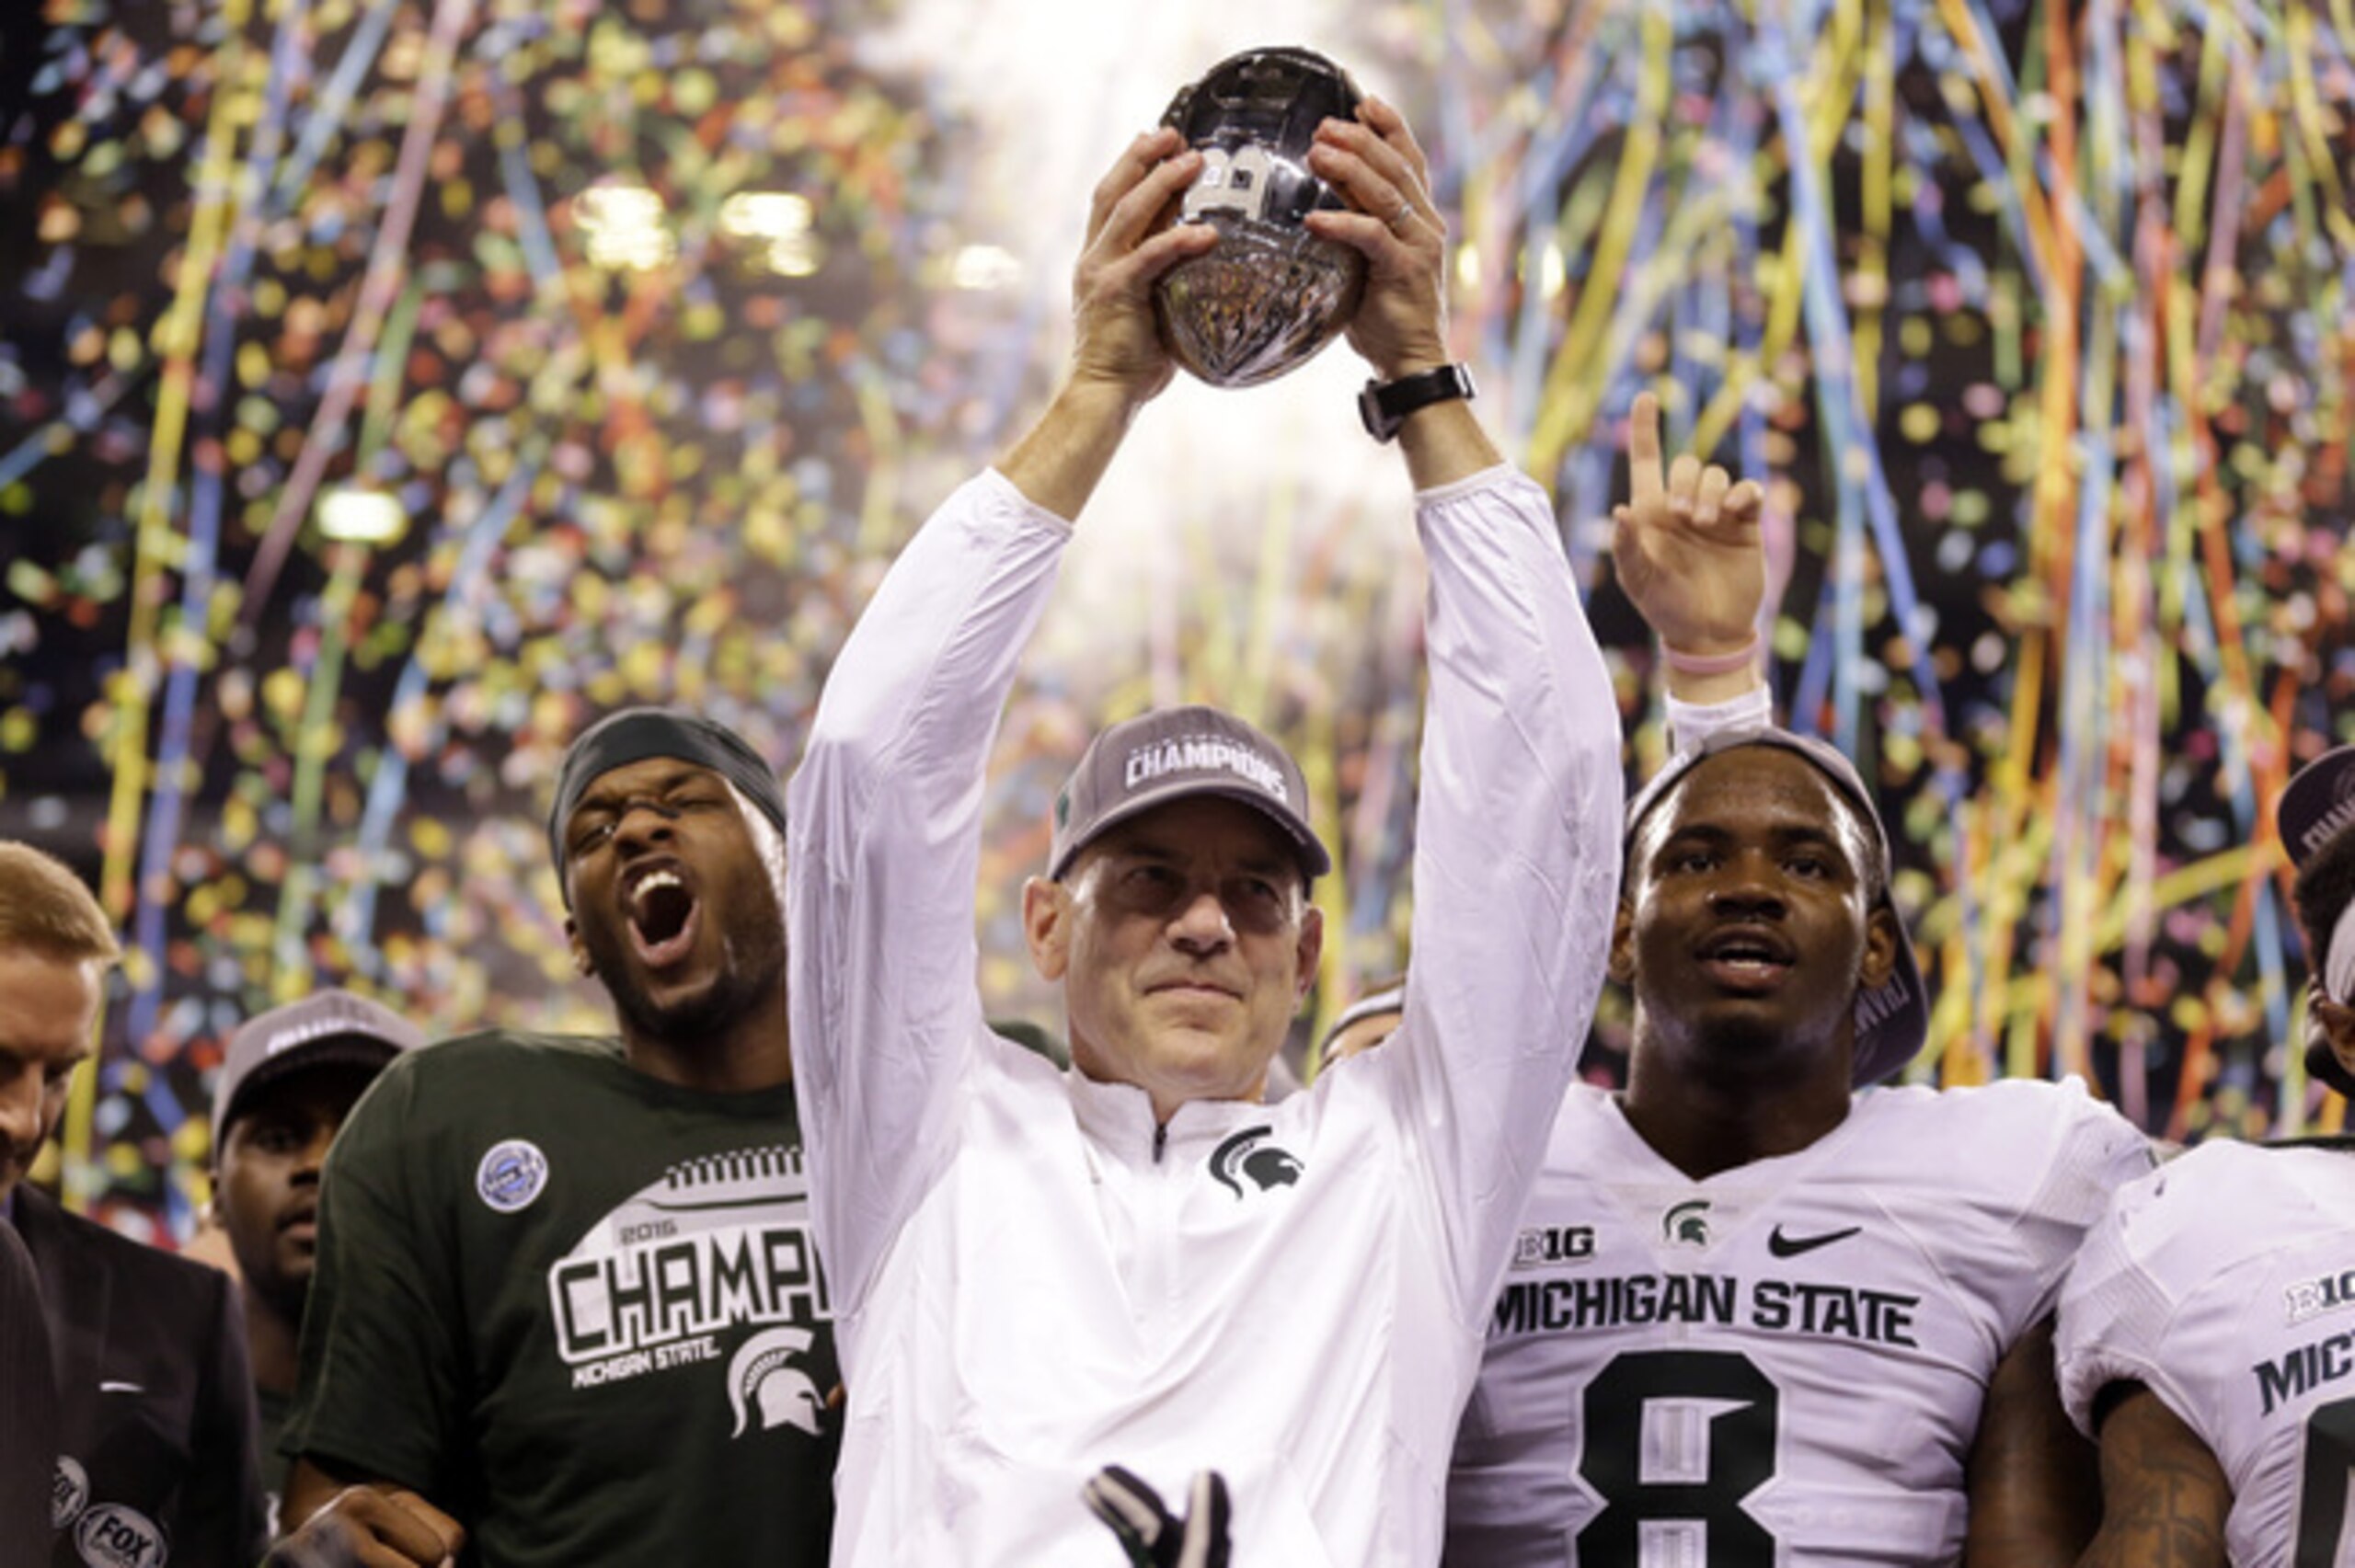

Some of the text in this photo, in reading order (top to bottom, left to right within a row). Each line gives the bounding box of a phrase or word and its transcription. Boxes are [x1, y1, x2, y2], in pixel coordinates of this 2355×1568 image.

[1126, 741, 1287, 804] CHAMPIONS
[1485, 1273, 1922, 1349] MICHIGAN STATE
[655, 1335, 722, 1369] STATE
[2251, 1328, 2355, 1418] MIC
[1576, 1349, 1780, 1568] 8
[95, 1515, 153, 1562] FOX
